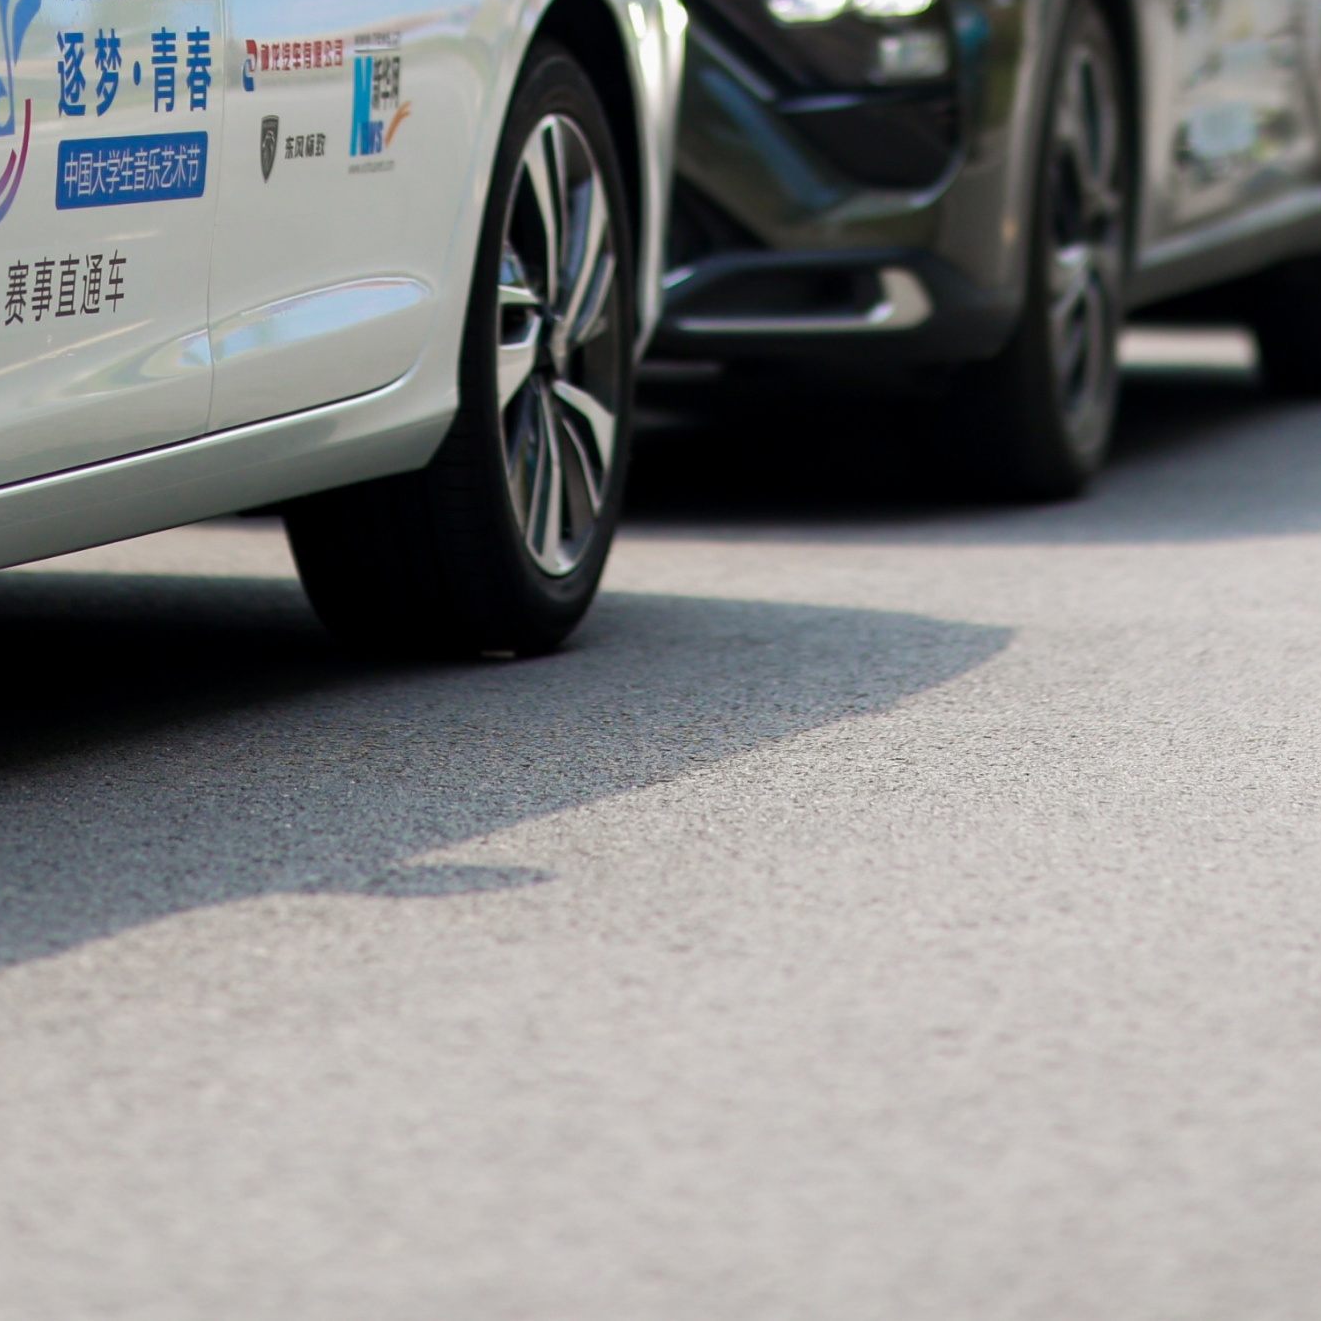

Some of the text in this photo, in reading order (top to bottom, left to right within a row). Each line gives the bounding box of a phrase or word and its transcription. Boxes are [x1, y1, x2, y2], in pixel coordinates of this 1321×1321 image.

[55, 25, 213, 117] 逐梦·青春
[63, 142, 202, 199] 中国大学生音乐艺术节
[284, 133, 327, 160] 东风标致
[4, 249, 127, 326] 赛事直通车
